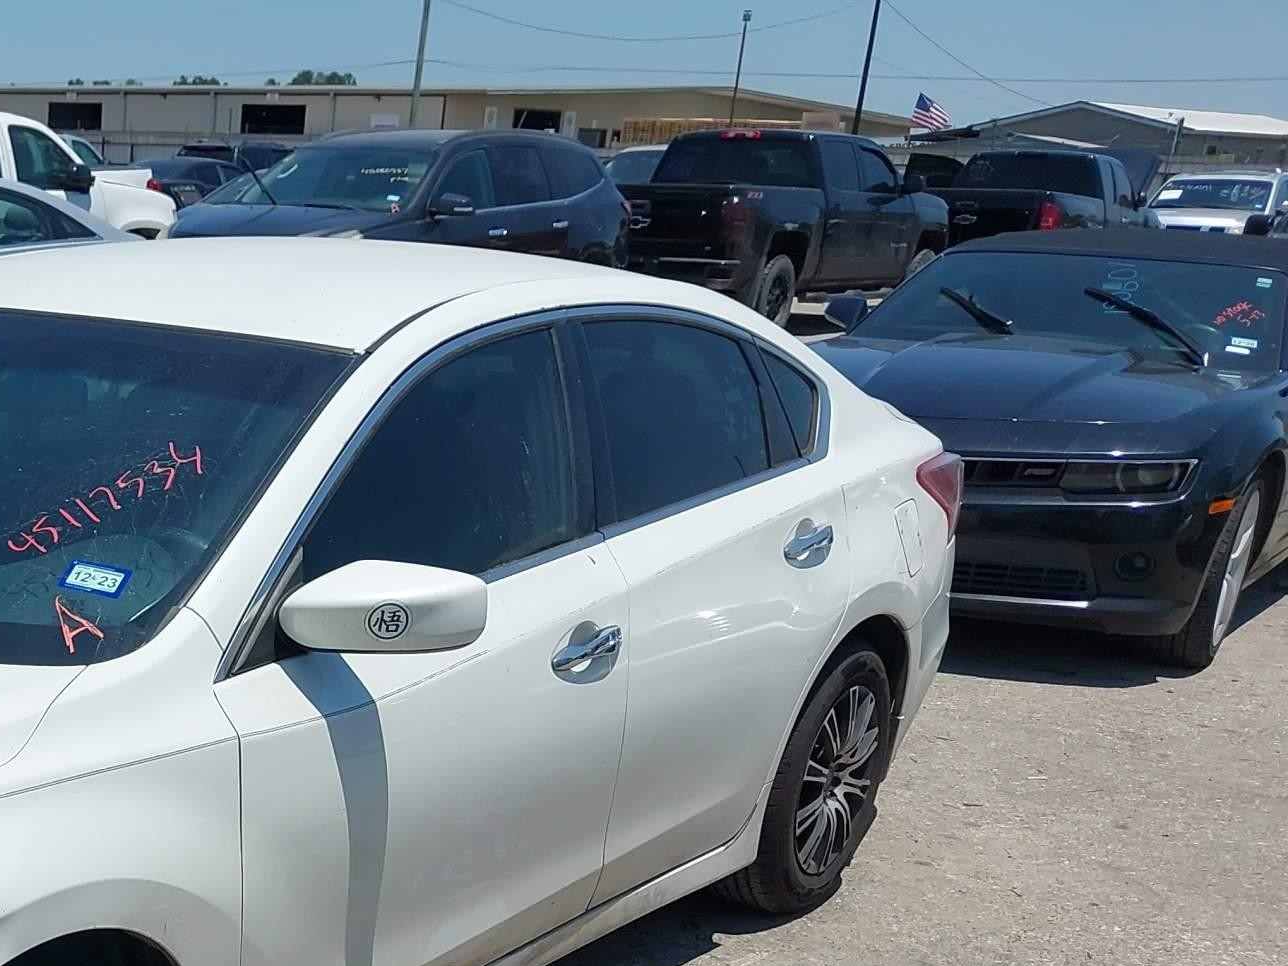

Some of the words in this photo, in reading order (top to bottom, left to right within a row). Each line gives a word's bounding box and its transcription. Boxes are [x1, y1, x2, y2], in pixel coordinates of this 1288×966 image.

[7, 441, 204, 554] 45117534
[54, 594, 105, 655] A
[372, 608, 405, 635] 悟
